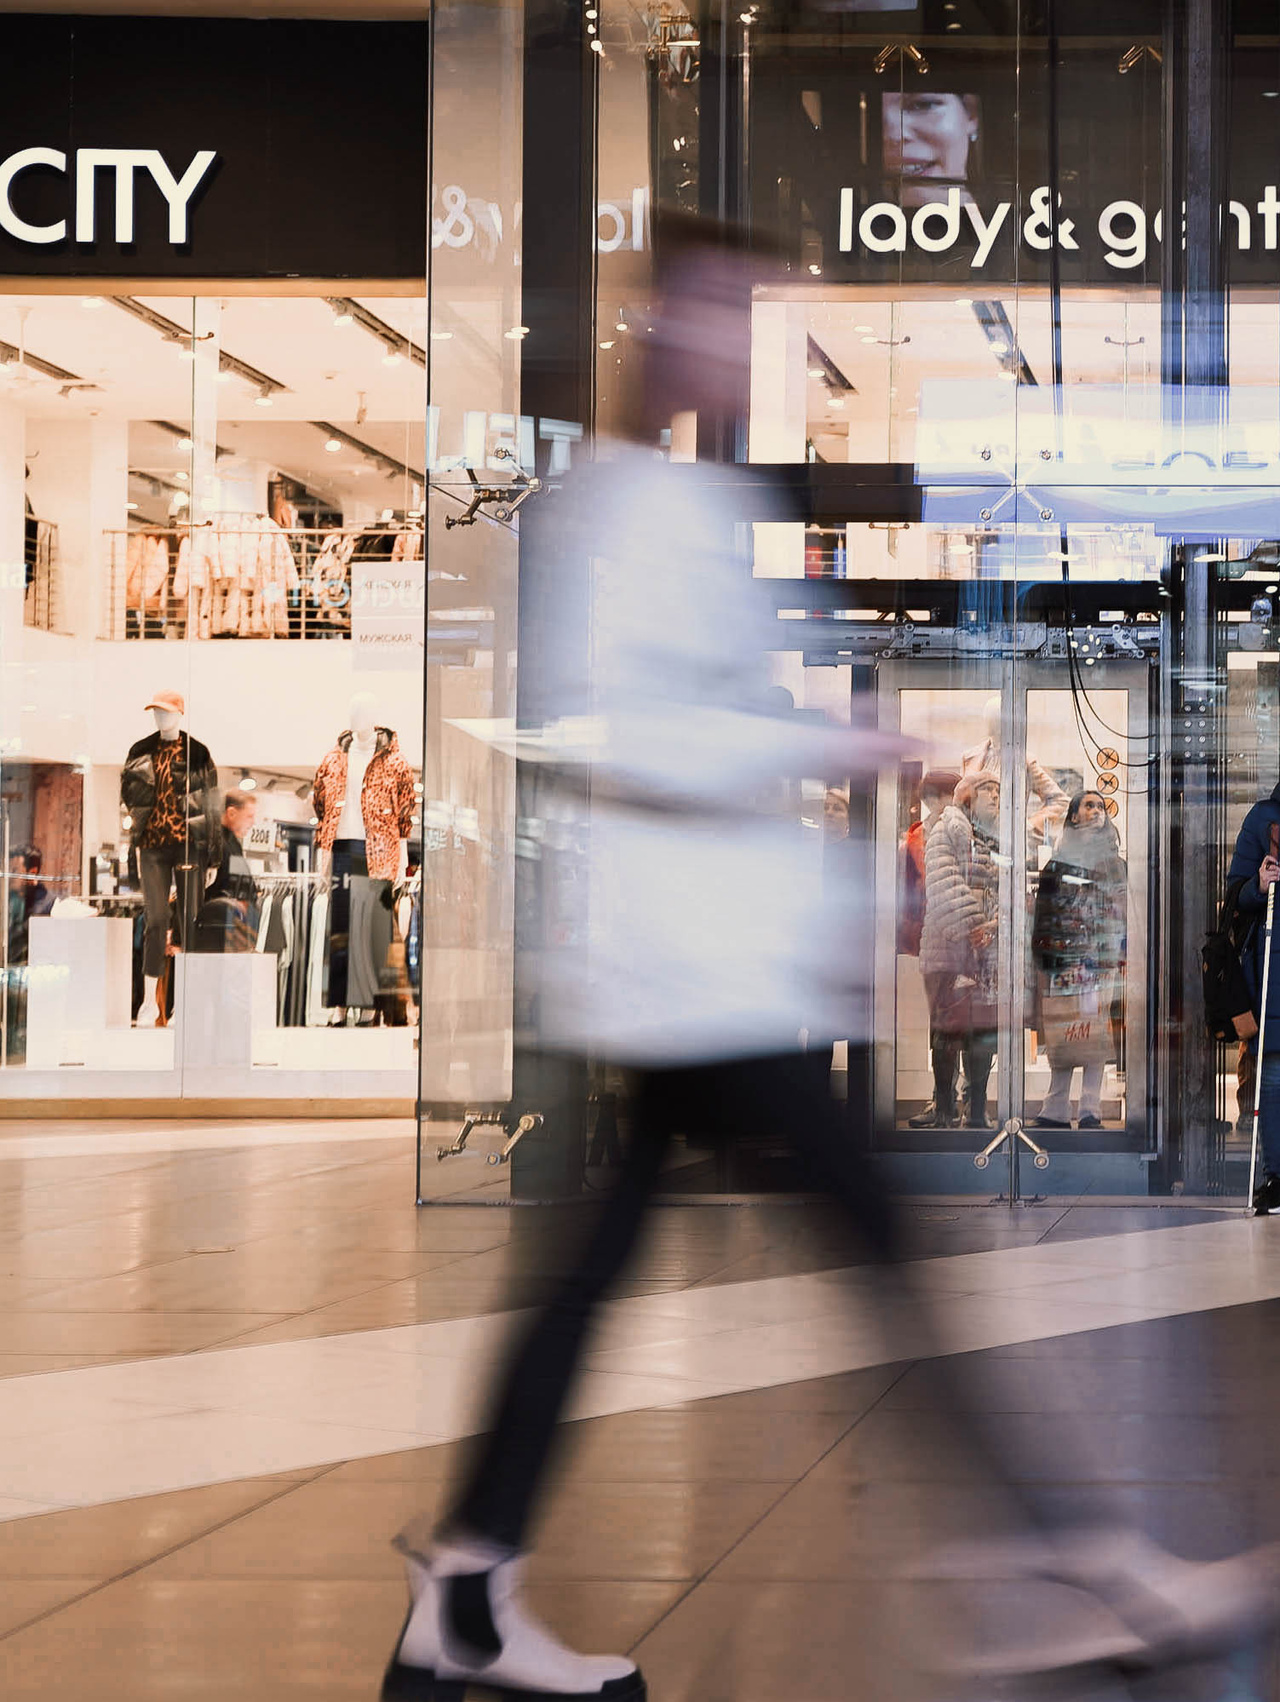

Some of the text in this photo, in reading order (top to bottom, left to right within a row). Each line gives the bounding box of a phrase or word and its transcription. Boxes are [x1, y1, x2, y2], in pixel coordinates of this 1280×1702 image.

[0, 147, 217, 244] CITY
[839, 187, 1012, 267] lady
[1023, 186, 1080, 250] &
